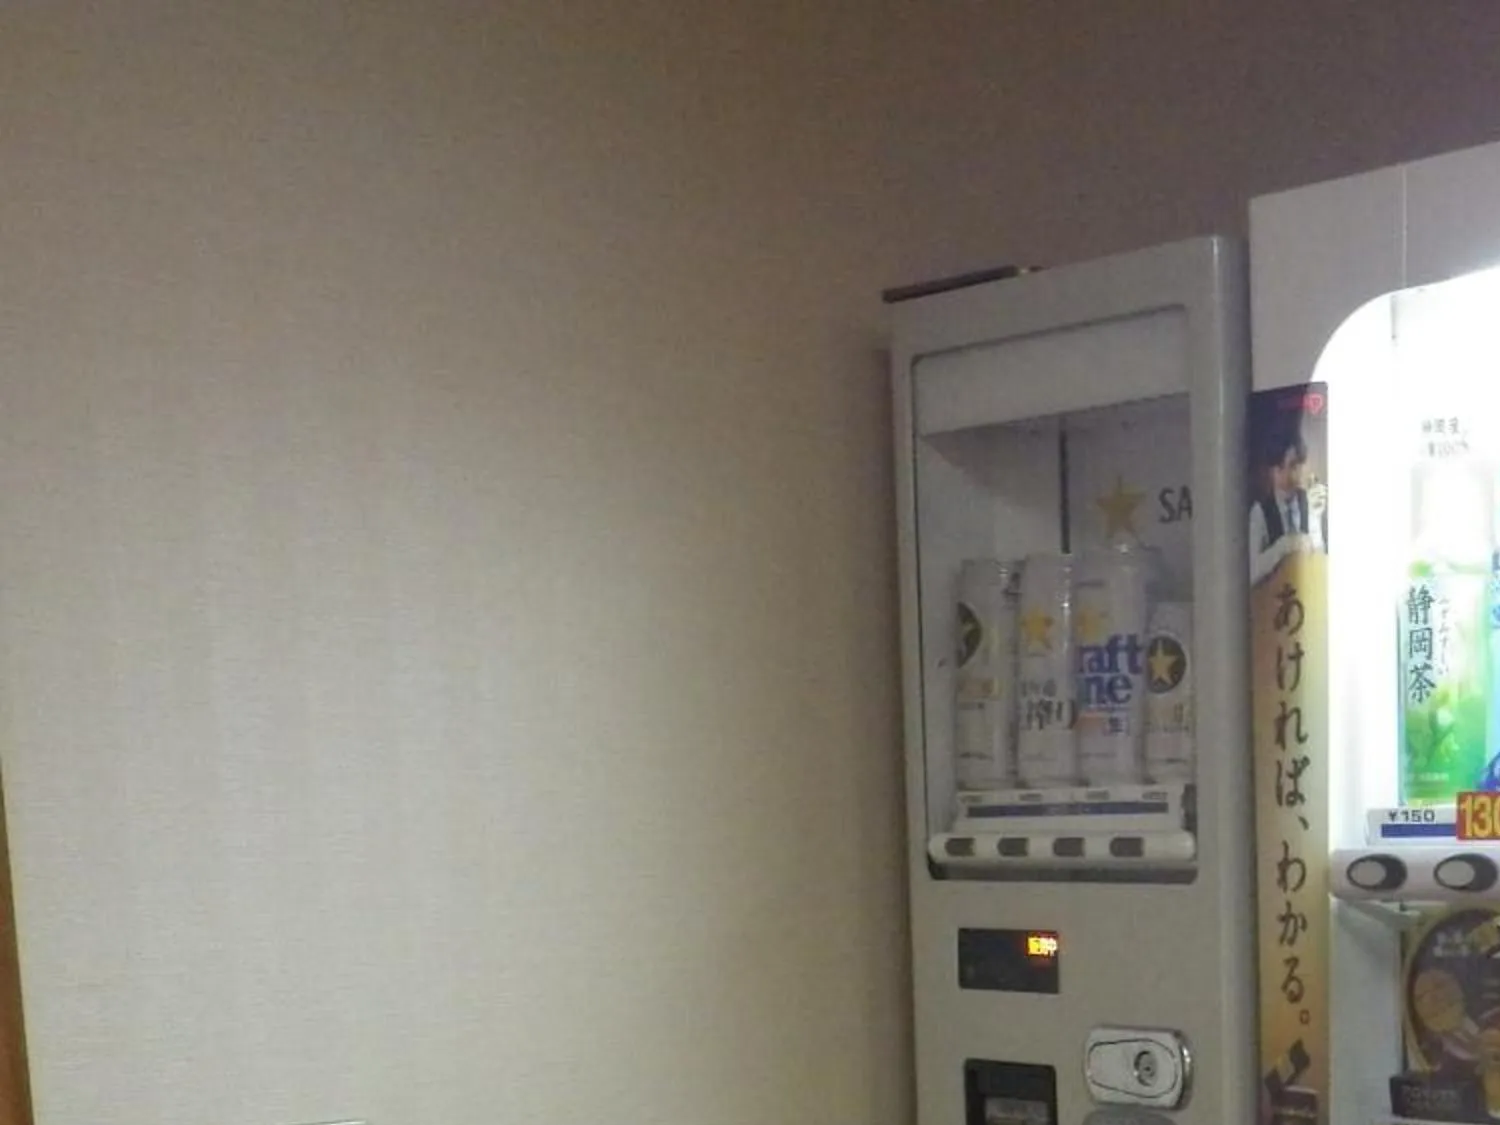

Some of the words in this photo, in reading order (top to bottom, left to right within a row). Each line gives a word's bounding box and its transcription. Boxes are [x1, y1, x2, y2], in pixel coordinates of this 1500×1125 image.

[1407, 583, 1438, 704] 静岡茶
[1273, 584, 1311, 1025] あければ、わかる。
